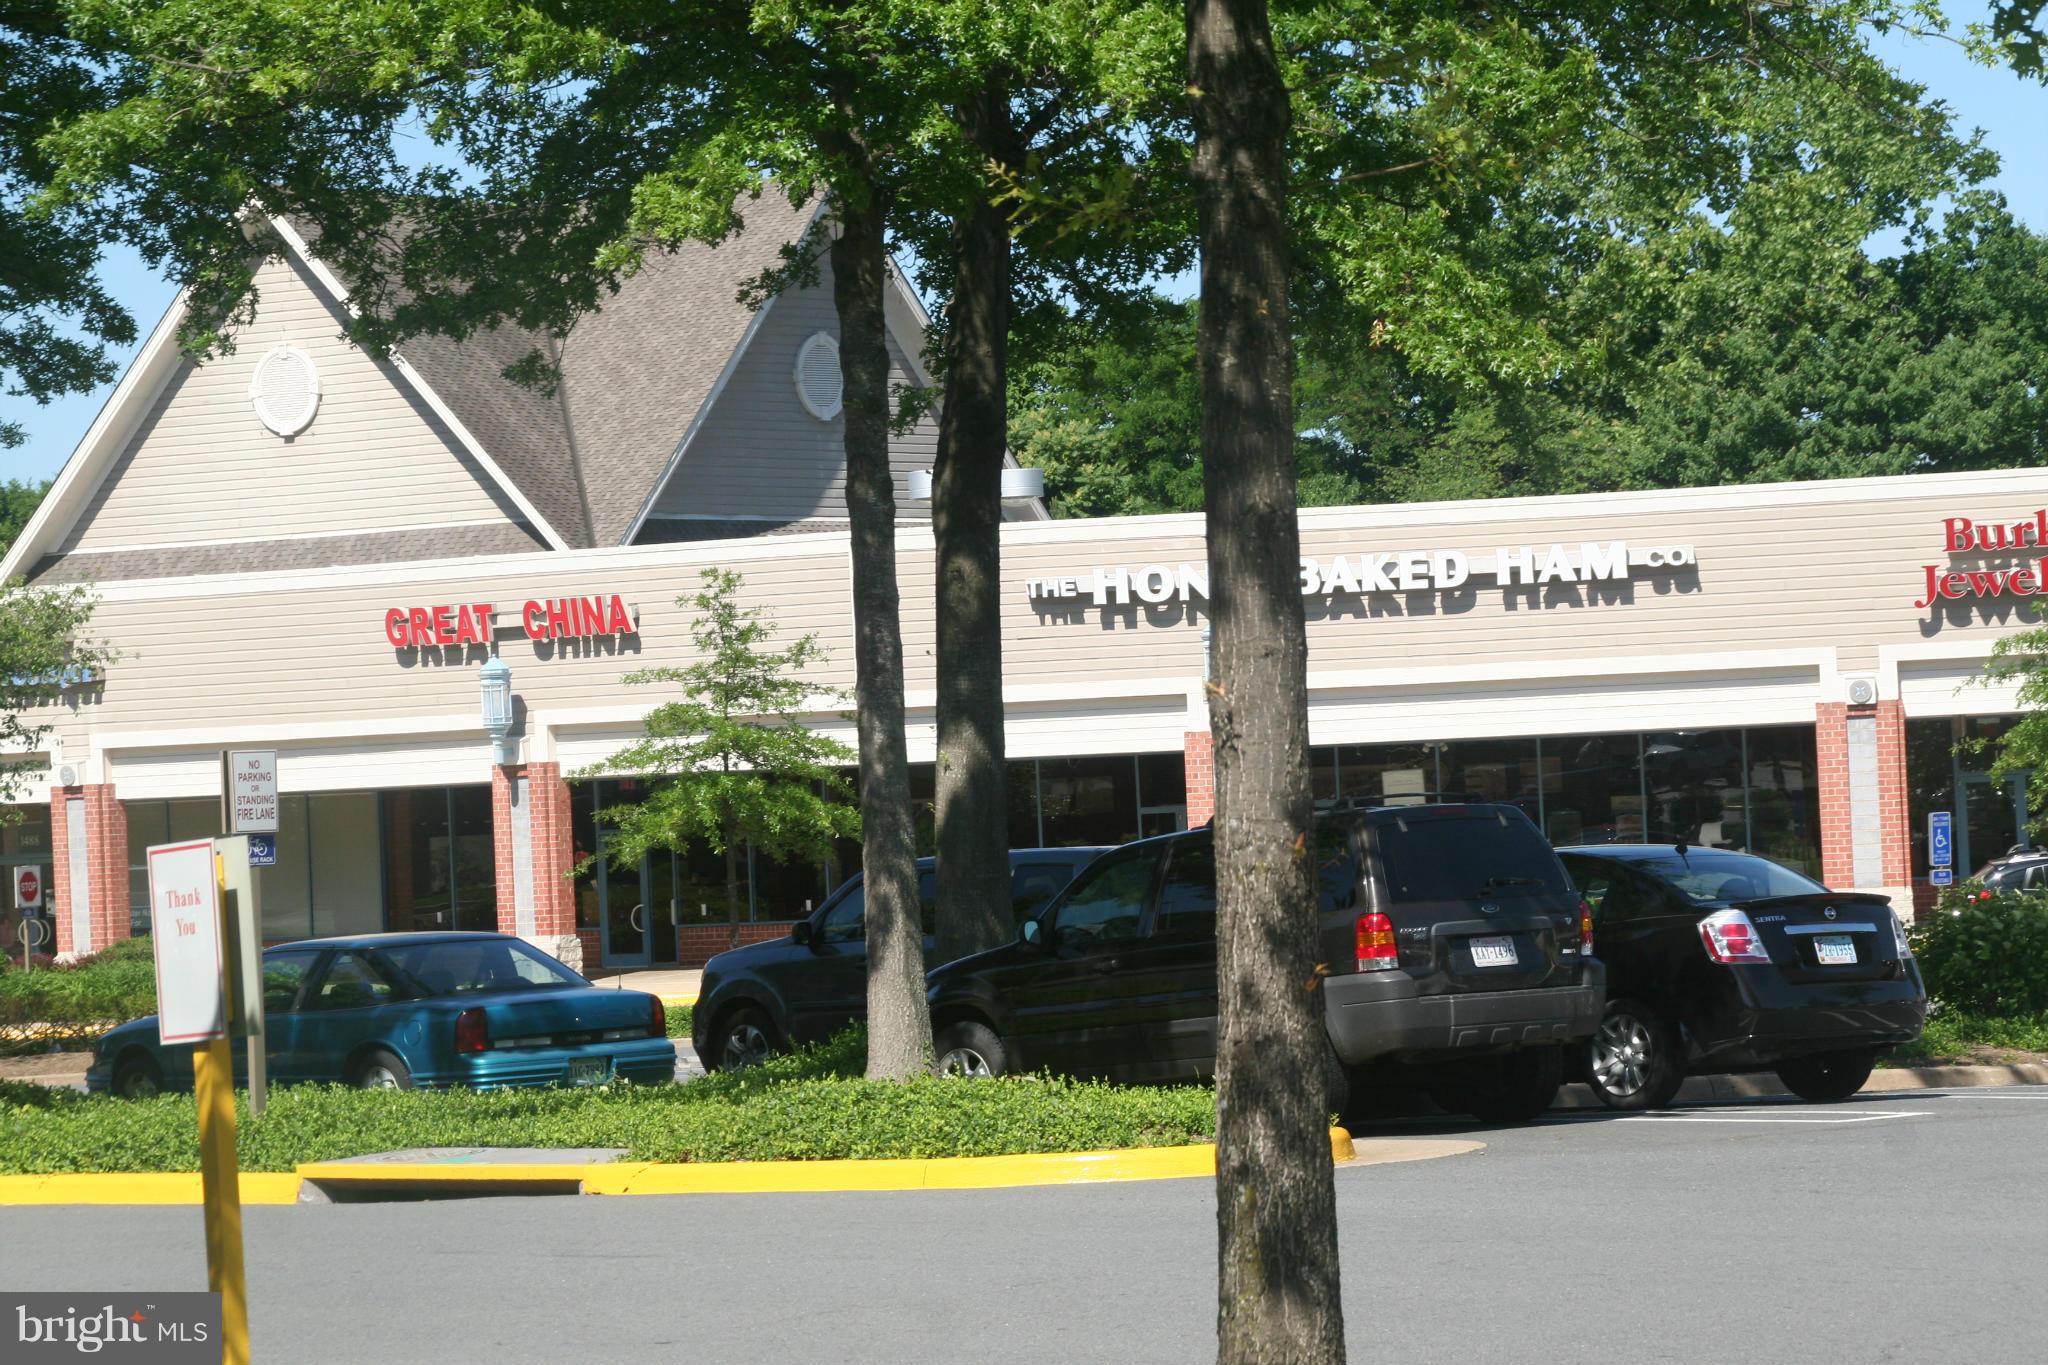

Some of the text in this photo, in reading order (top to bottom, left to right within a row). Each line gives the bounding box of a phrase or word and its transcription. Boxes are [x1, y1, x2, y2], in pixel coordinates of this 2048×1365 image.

[1026, 577, 1078, 599] THE
[1495, 541, 1630, 586] HAM
[385, 594, 636, 648] GREAT CHINA
[248, 759, 261, 770] NO
[238, 772, 272, 782] PARKING
[250, 784, 260, 793] OR
[237, 794, 275, 806] STANDING
[237, 807, 275, 821] FIRE LANE
[20, 882, 37, 892] STOP
[165, 887, 202, 909] Thank
[175, 918, 197, 937] You
